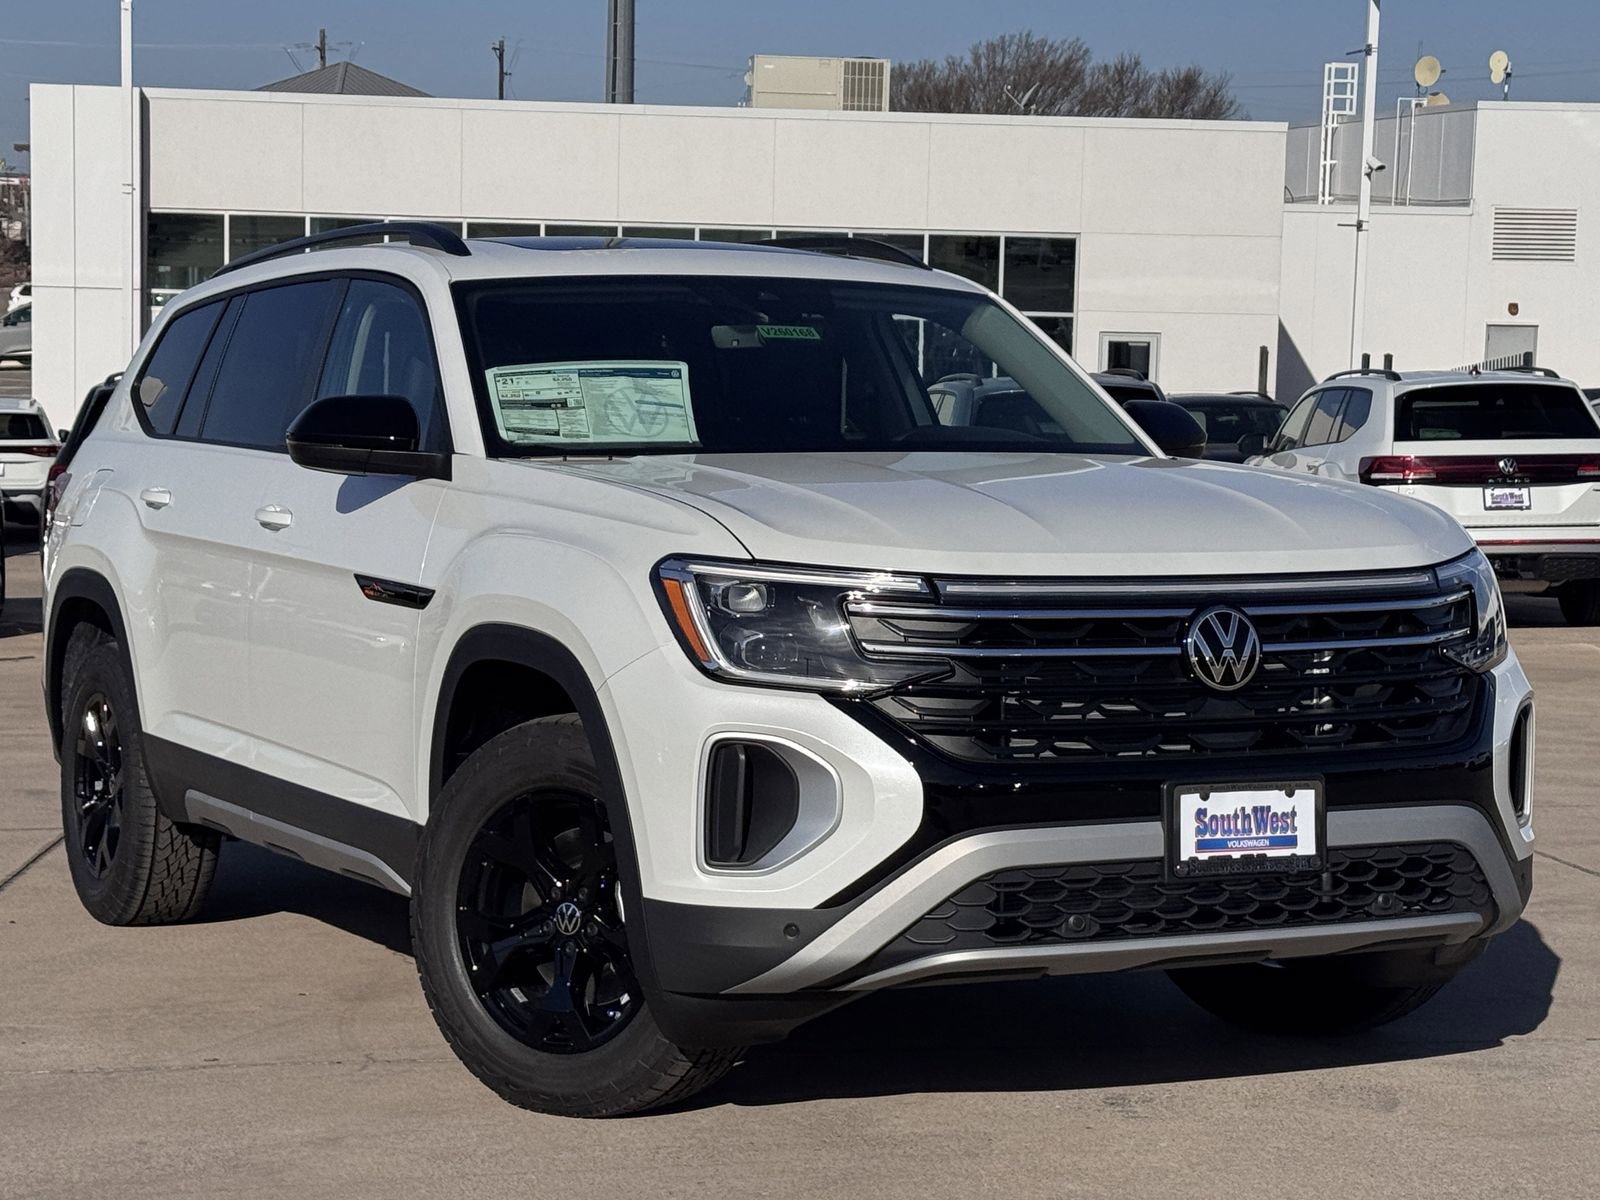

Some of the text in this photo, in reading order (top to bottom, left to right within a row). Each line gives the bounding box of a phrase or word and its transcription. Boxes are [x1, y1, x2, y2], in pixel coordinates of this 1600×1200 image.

[1190, 608, 1259, 688] VW
[1194, 804, 1298, 838] SouthWest
[1227, 839, 1270, 848] VOLKSWAGEN
[556, 903, 580, 935] VW
